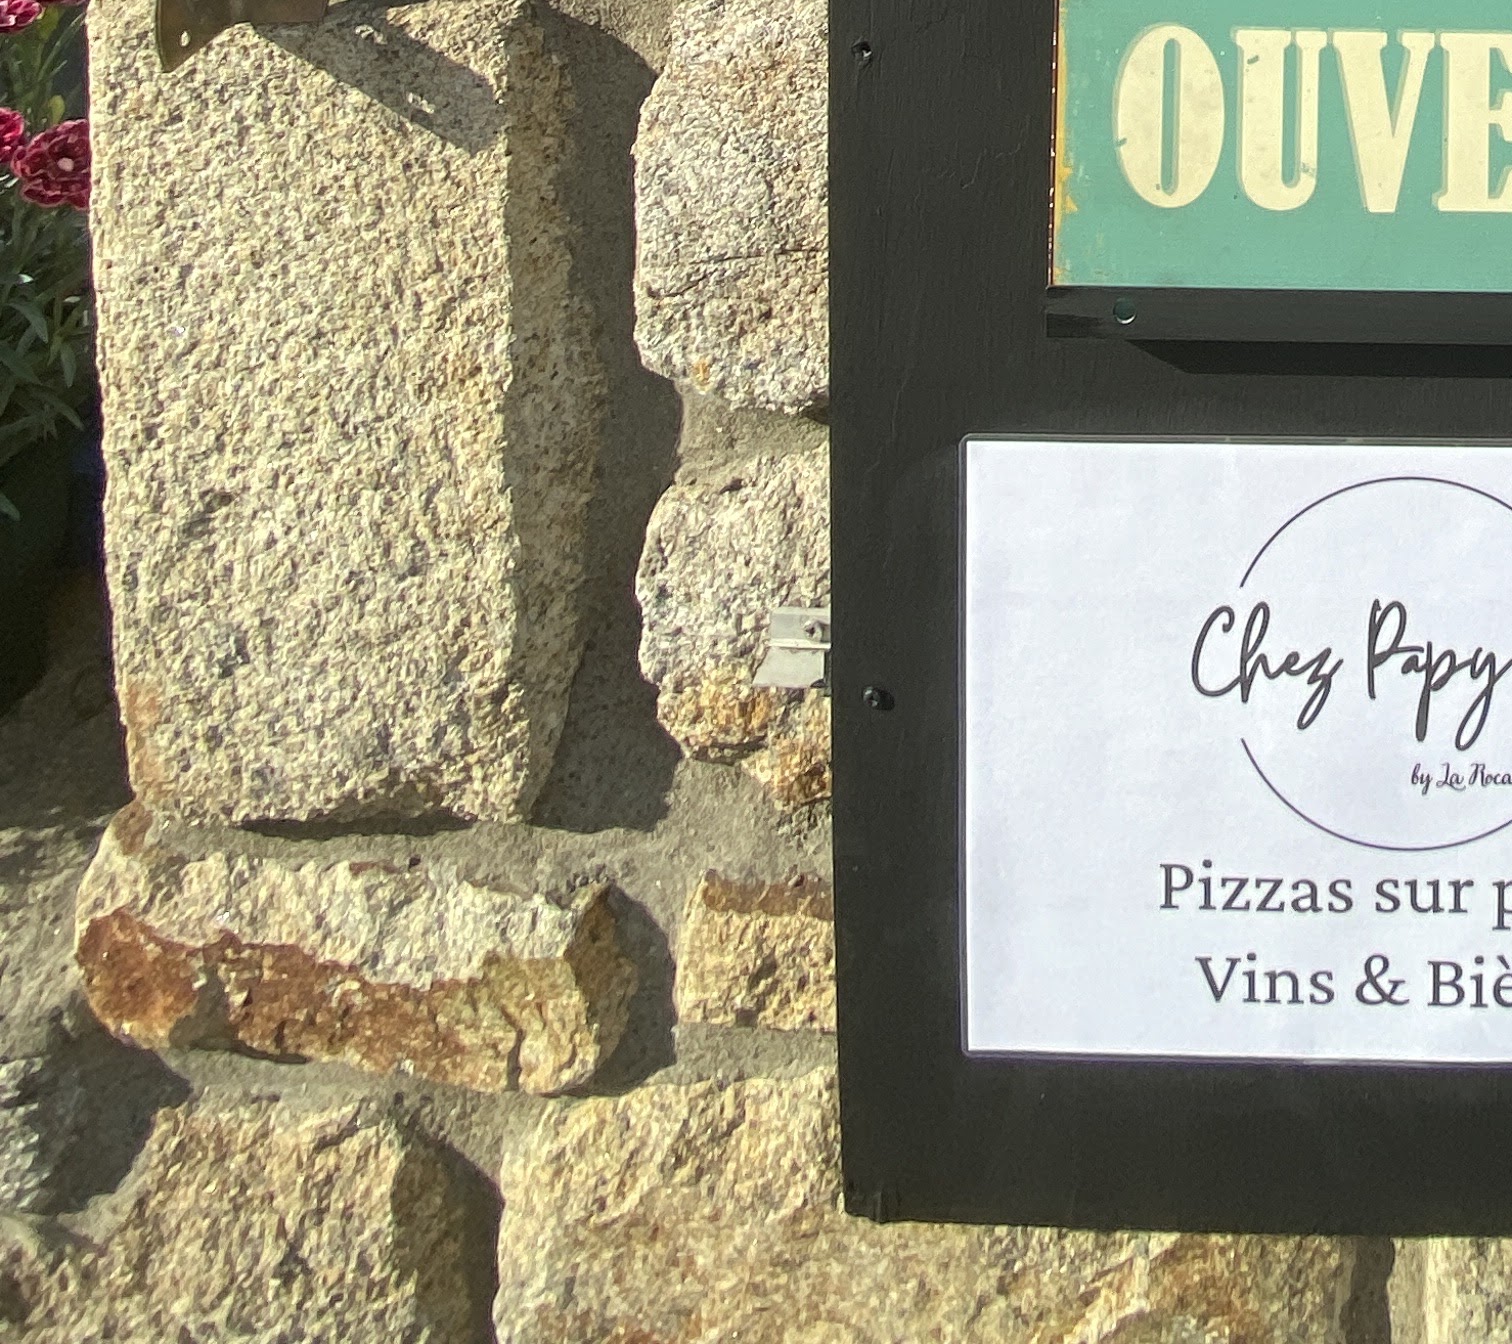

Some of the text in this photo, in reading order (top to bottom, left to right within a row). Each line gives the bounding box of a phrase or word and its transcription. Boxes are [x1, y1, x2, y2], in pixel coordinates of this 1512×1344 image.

[1191, 601, 1344, 730] Chez
[1410, 763, 1431, 796] by
[1435, 762, 1464, 792] La
[1159, 859, 1354, 914] Pizzas
[1375, 873, 1474, 915] sur
[1196, 952, 1336, 1005] Vins
[1356, 953, 1411, 1006] &
